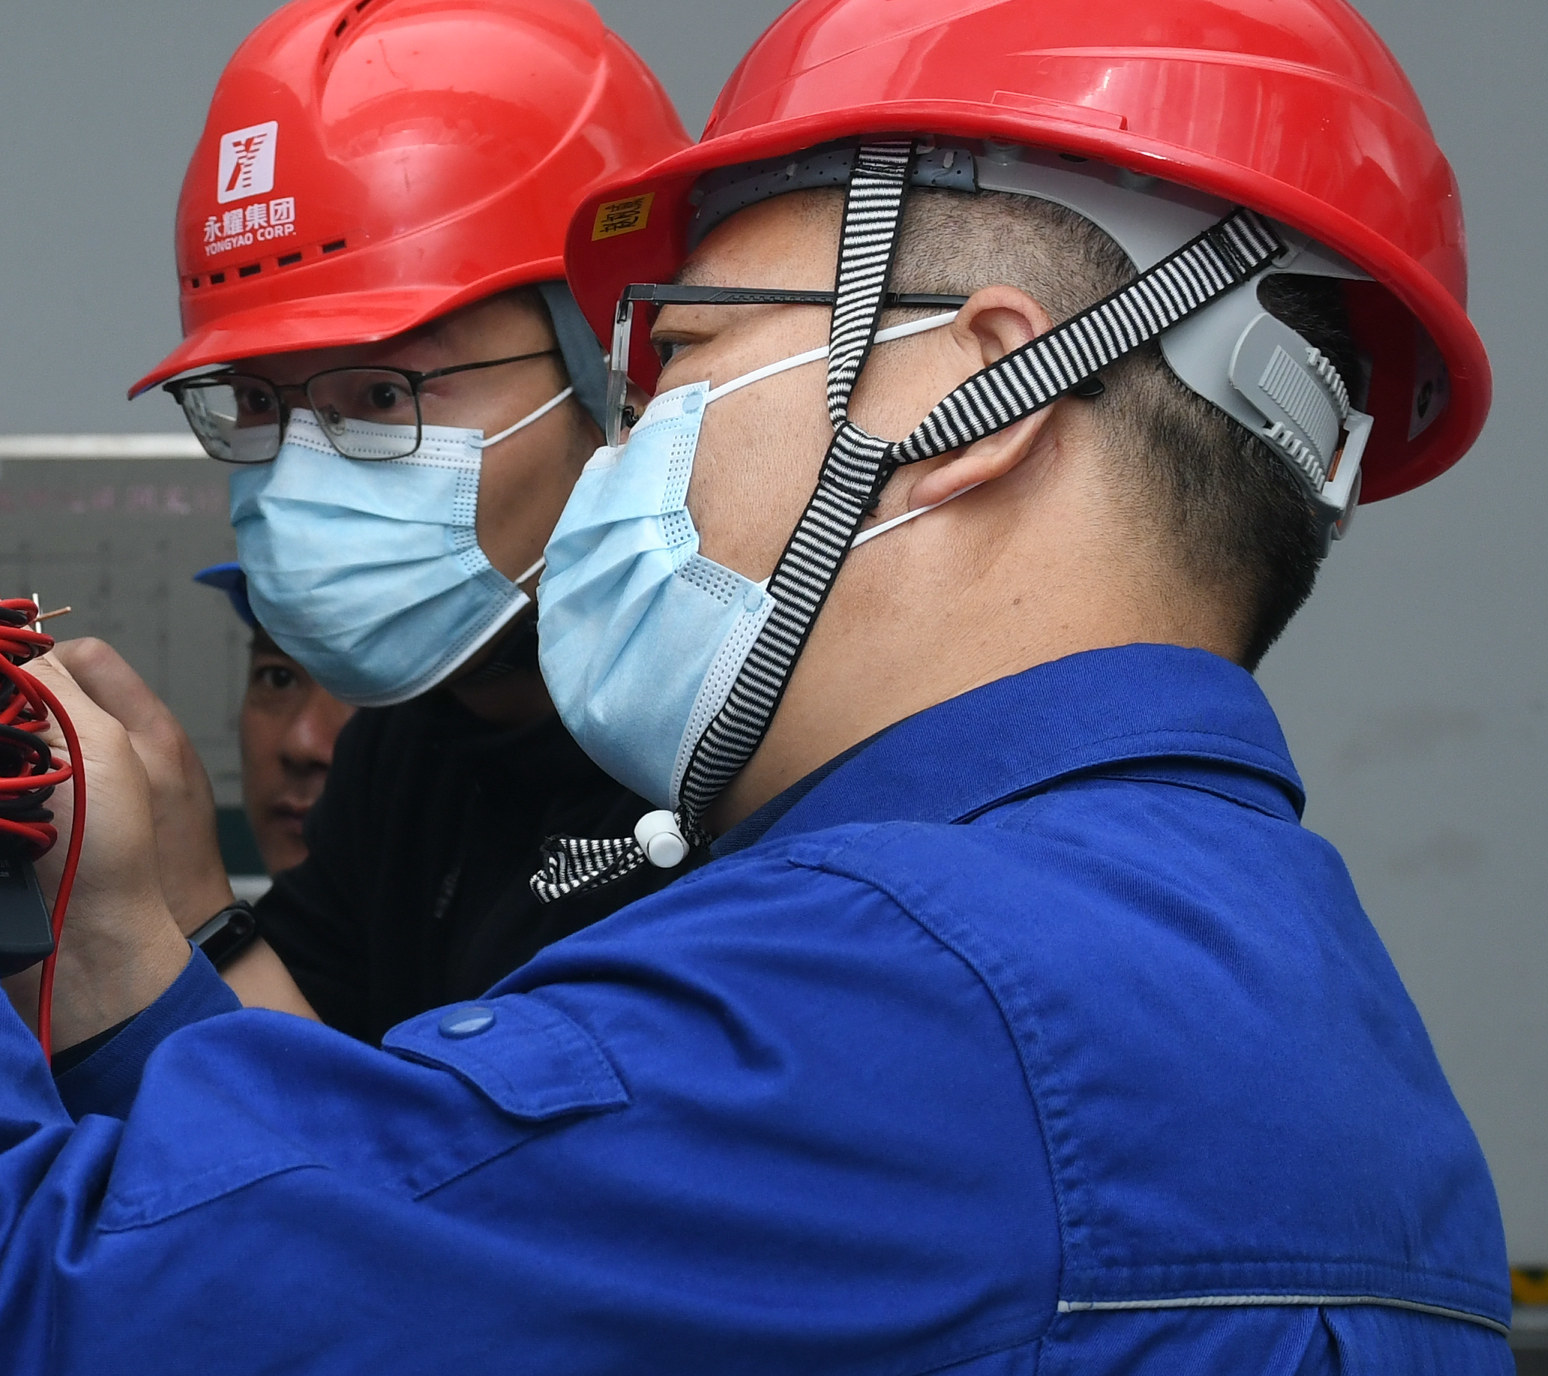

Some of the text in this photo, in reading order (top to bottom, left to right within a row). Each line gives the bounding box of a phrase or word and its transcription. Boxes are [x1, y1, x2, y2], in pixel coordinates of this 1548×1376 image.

[204, 196, 296, 243] 永耀集团
[204, 223, 297, 257] YONGYAO CORP.
